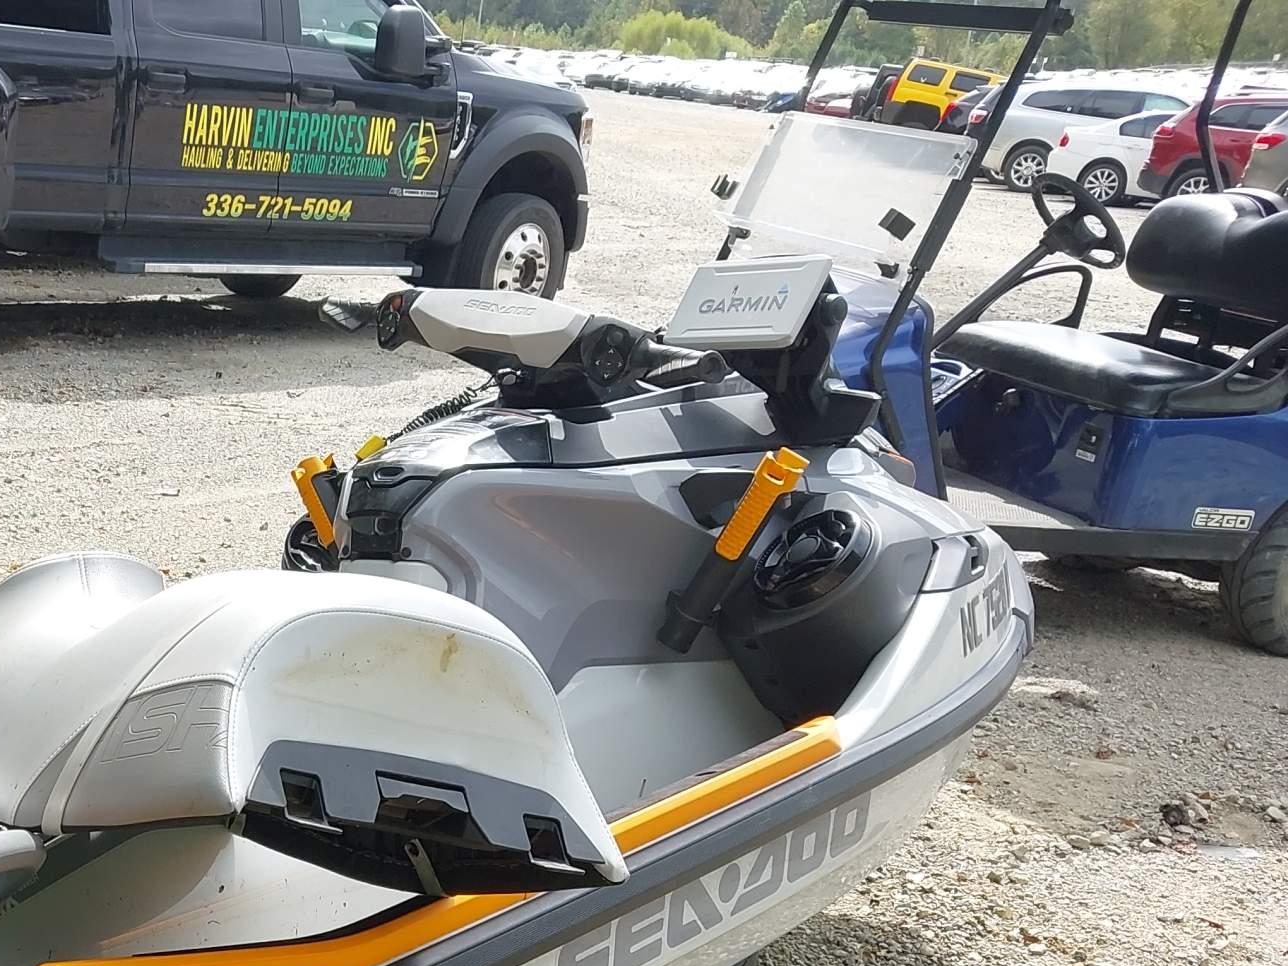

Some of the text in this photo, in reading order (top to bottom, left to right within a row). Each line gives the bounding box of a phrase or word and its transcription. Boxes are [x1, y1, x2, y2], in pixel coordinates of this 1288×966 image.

[182, 103, 396, 156] HARVIN ENTERPRISES INC
[181, 145, 388, 178] HAULING & DELIVERING BEYOND EXPECTATIONS
[202, 193, 353, 221] 336-721-5094
[698, 294, 788, 314] GARMIN
[959, 594, 983, 658] NC
